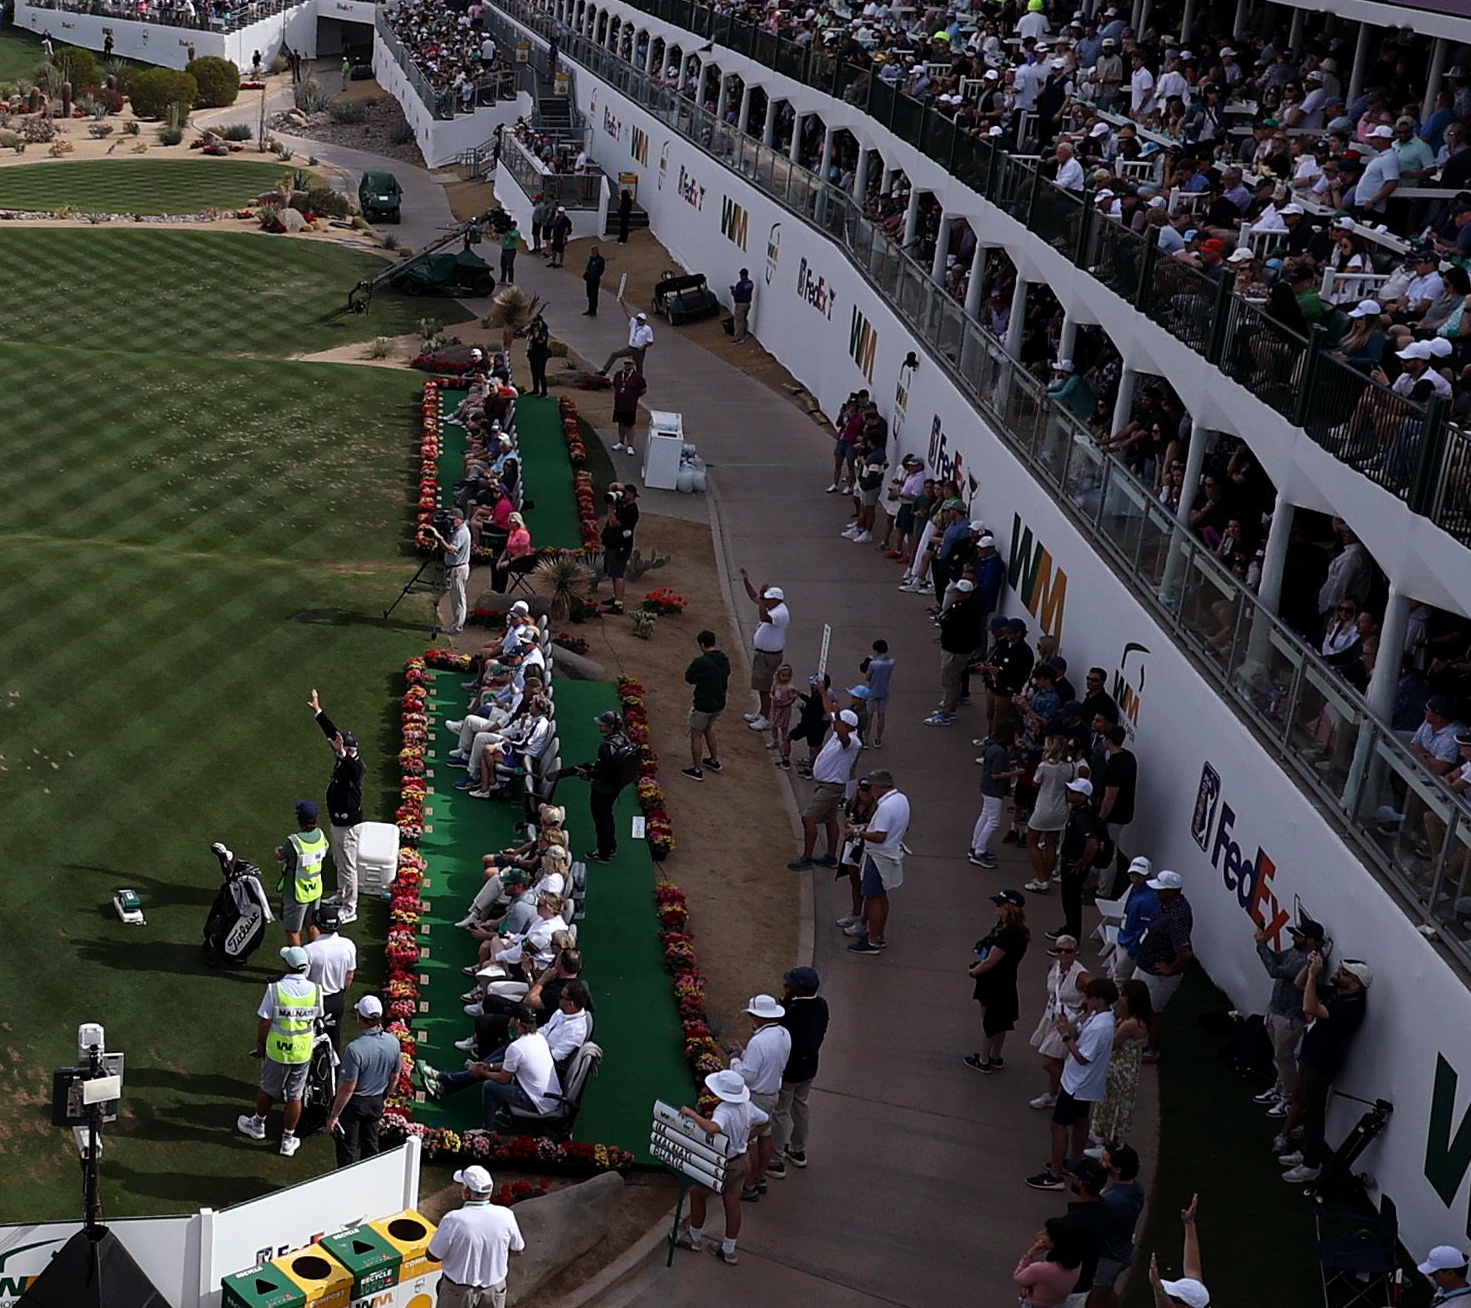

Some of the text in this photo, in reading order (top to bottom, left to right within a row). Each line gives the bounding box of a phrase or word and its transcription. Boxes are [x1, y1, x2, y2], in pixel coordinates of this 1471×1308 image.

[721, 194, 749, 253] WM
[804, 268, 826, 317] FedEx
[849, 304, 878, 386] WM
[1007, 511, 1067, 649] WM
[1113, 669, 1141, 727] WM
[1211, 801, 1290, 952] FedEx
[360, 1268, 392, 1285] RECYCLE
[404, 1256, 427, 1269] COMP
